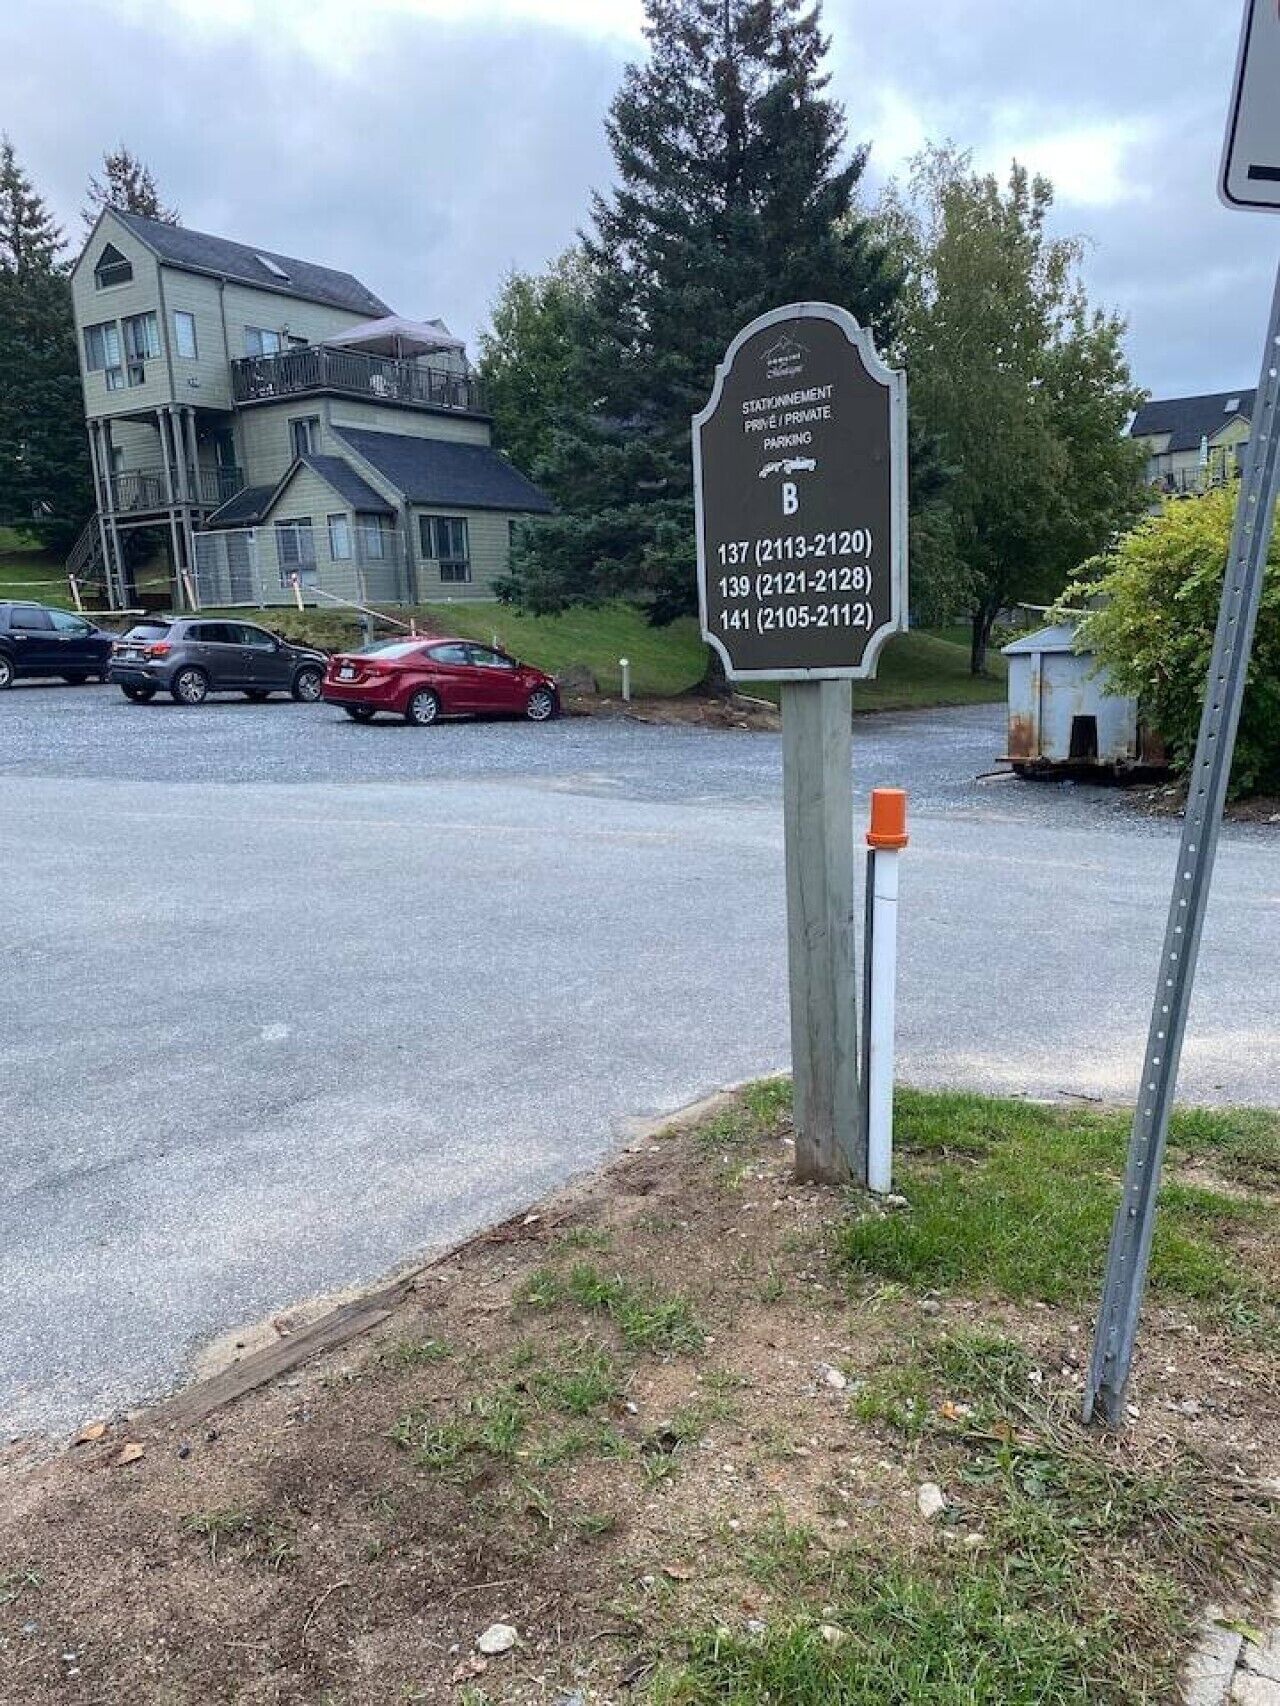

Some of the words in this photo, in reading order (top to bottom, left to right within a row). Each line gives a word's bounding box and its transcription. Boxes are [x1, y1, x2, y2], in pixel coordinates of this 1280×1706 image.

[742, 384, 833, 415] STATIONNEMENT
[744, 414, 777, 433] PRIVÉ
[785, 405, 831, 426] PRIVATE
[763, 431, 812, 450] PARKING
[782, 482, 799, 515] B
[718, 541, 750, 565] 137
[755, 528, 872, 568] (2113-2120)
[719, 575, 750, 598] 139
[756, 564, 872, 602] (2121-2128)
[720, 608, 750, 630] 141
[757, 602, 874, 635] (2105-2112)
